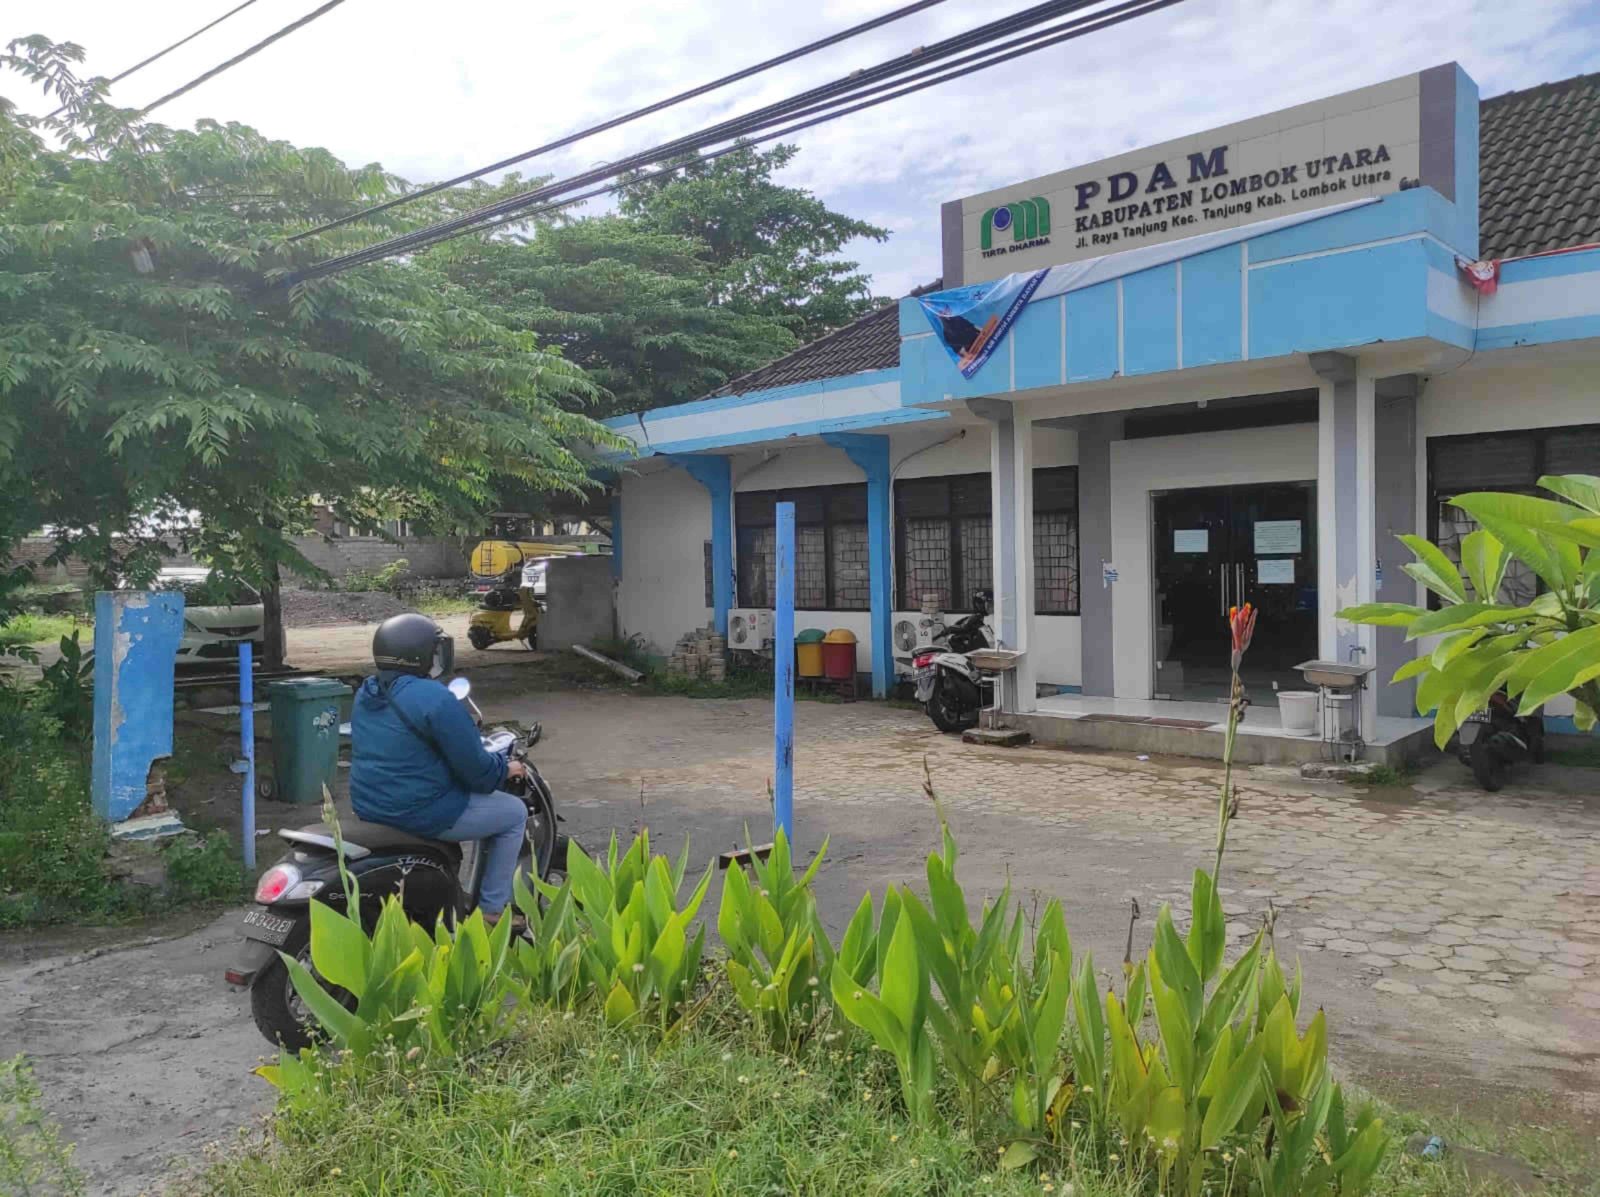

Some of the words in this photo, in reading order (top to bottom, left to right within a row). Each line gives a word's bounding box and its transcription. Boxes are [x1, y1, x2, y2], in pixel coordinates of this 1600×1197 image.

[1074, 145, 1228, 211] PDAM
[1074, 190, 1193, 232] KABUPATEN
[1200, 165, 1298, 204] LOMBOK
[1305, 144, 1391, 178] UTARA
[1075, 236, 1089, 249] Jl.
[1092, 231, 1118, 246] Raya
[1122, 220, 1168, 238] Tanjung
[1171, 214, 1198, 227] Kec.
[1202, 200, 1252, 220] Tanjung
[1256, 193, 1286, 208] Kab.
[1291, 178, 1347, 200] Lombok
[1352, 169, 1391, 187] Utara
[982, 248, 1007, 259] TIRTA
[1009, 237, 1051, 253] DHARMA
